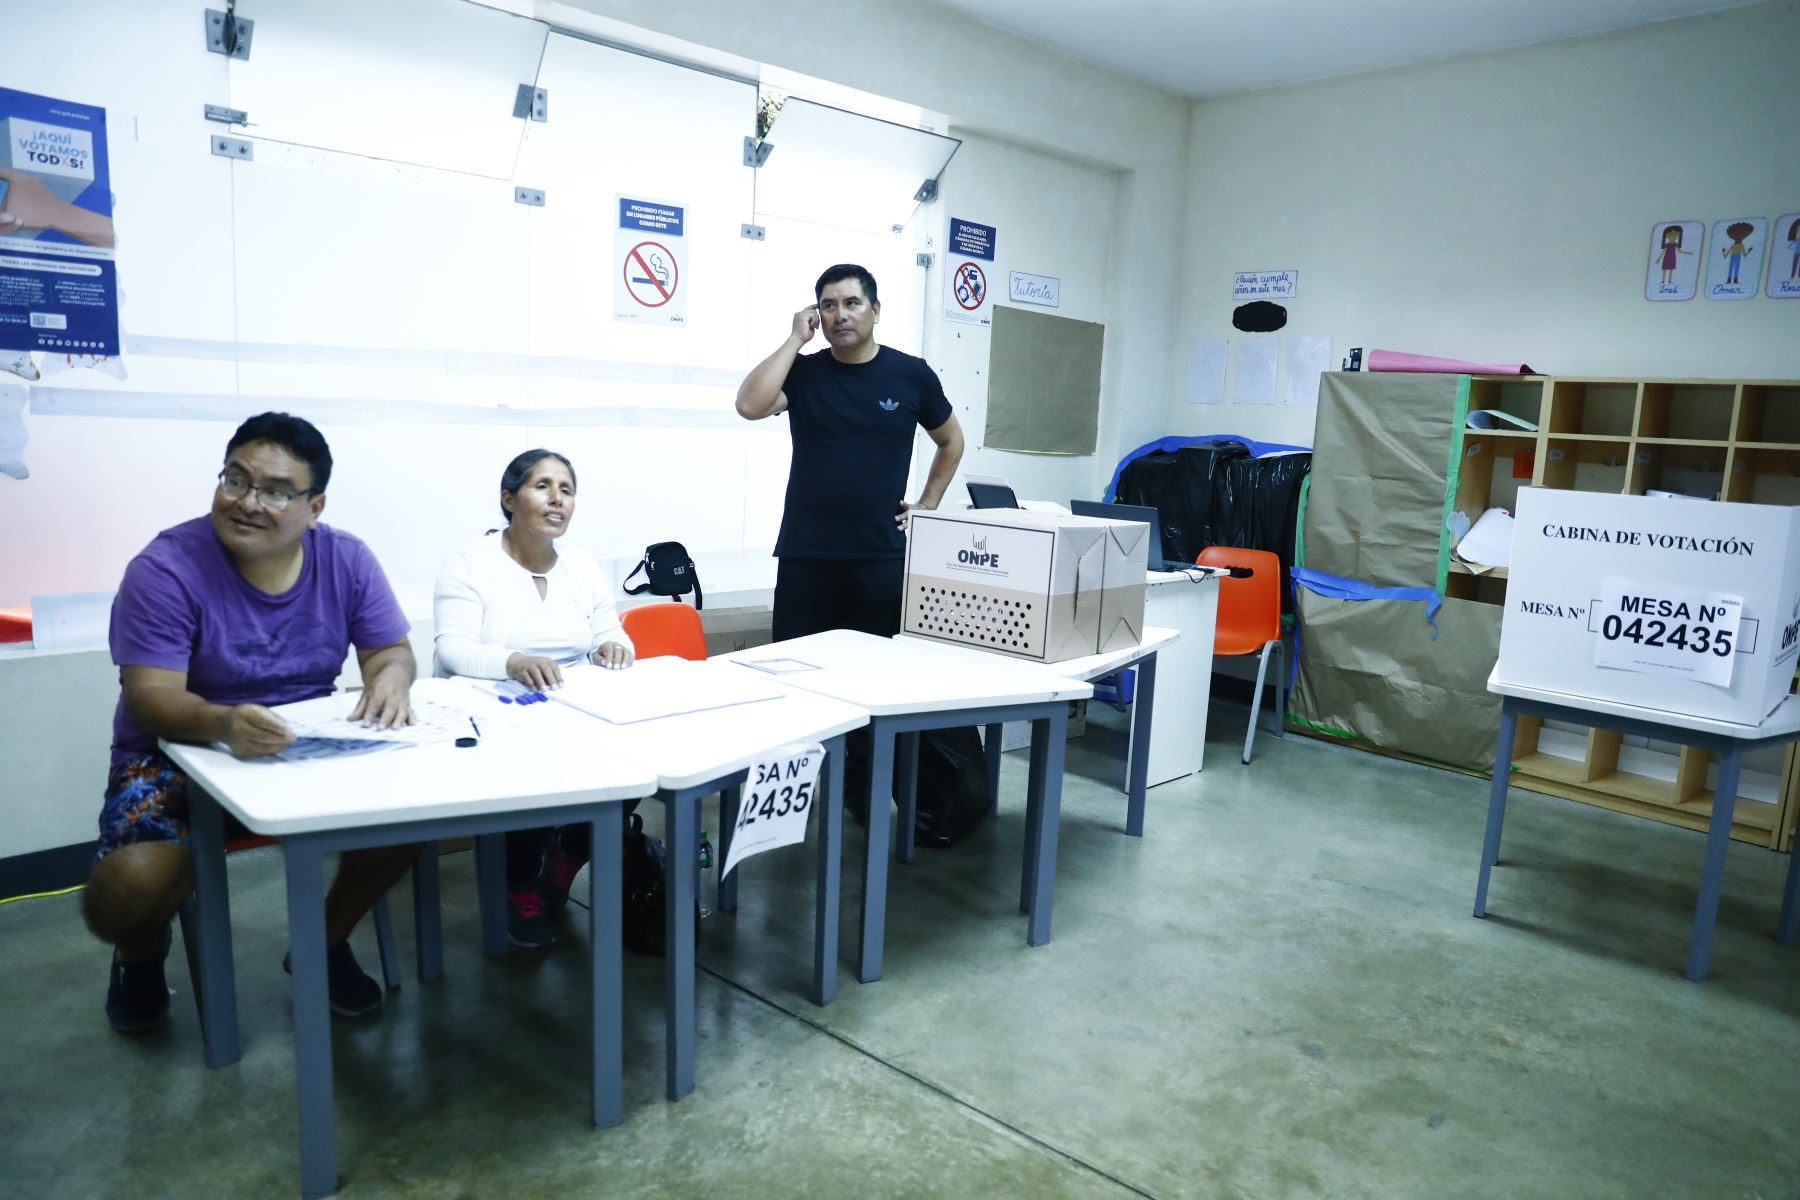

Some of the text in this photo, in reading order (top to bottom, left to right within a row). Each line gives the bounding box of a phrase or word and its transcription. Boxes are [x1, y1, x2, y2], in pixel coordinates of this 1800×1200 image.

[33, 131, 71, 145] ¡AQUÍ
[19, 138, 88, 158] VOTAMOS
[27, 151, 83, 169] TODXS!
[960, 225, 986, 236] PROHIBIDO
[1261, 272, 1288, 285] cumple
[1014, 277, 1054, 299] Tutoría
[1712, 284, 1745, 295] Omar
[1542, 524, 1755, 557] CABINA DE VOTACIÓN
[958, 550, 999, 568] ONPE
[674, 566, 685, 575] CAT
[1520, 600, 1564, 618] MESA
[1620, 595, 1726, 623] MESA Nº
[1602, 614, 1733, 657] 042435
